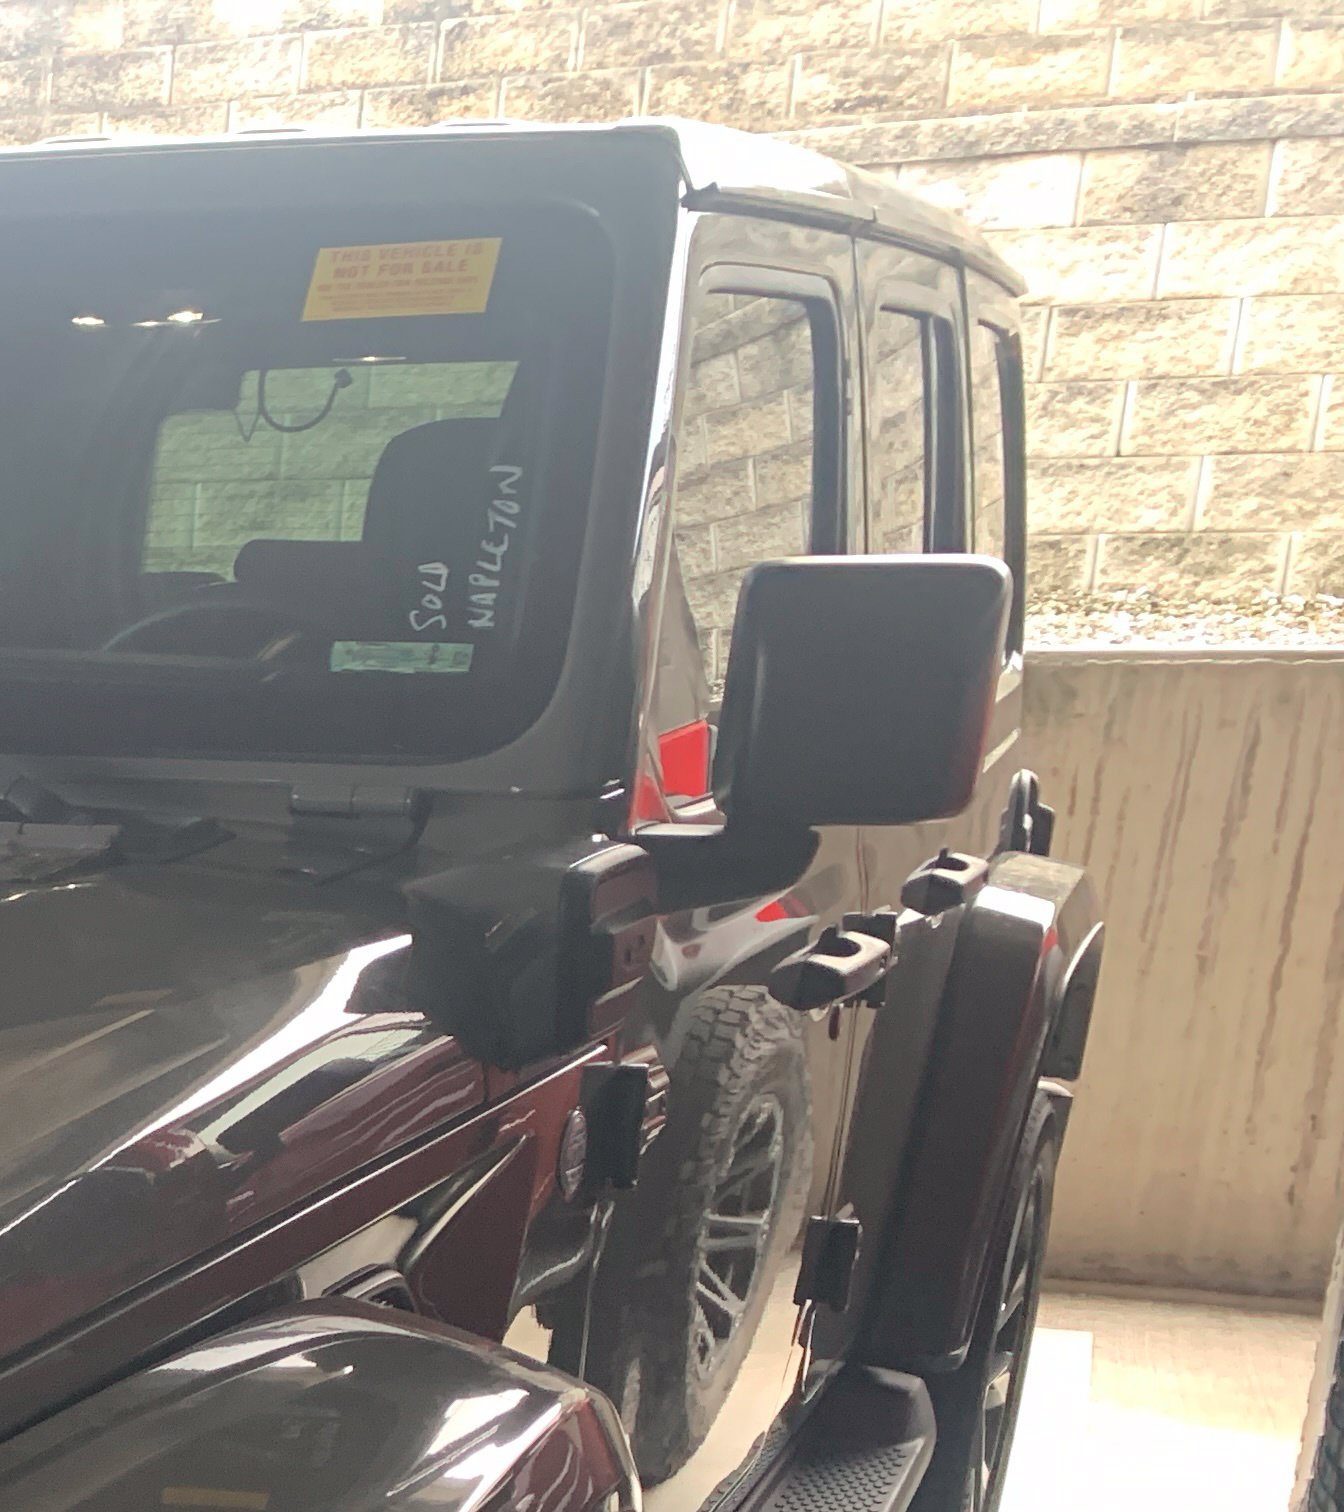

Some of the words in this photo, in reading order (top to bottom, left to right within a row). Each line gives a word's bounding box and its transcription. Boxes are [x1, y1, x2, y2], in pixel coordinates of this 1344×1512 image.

[331, 250, 371, 264] THIS
[379, 243, 456, 260] VEHICLE
[464, 242, 482, 255] IS
[333, 266, 370, 278] NOT
[377, 262, 414, 277] FOR
[422, 259, 468, 273] SALE
[467, 464, 523, 628] NAPLETON
[409, 561, 449, 631] SOLD
